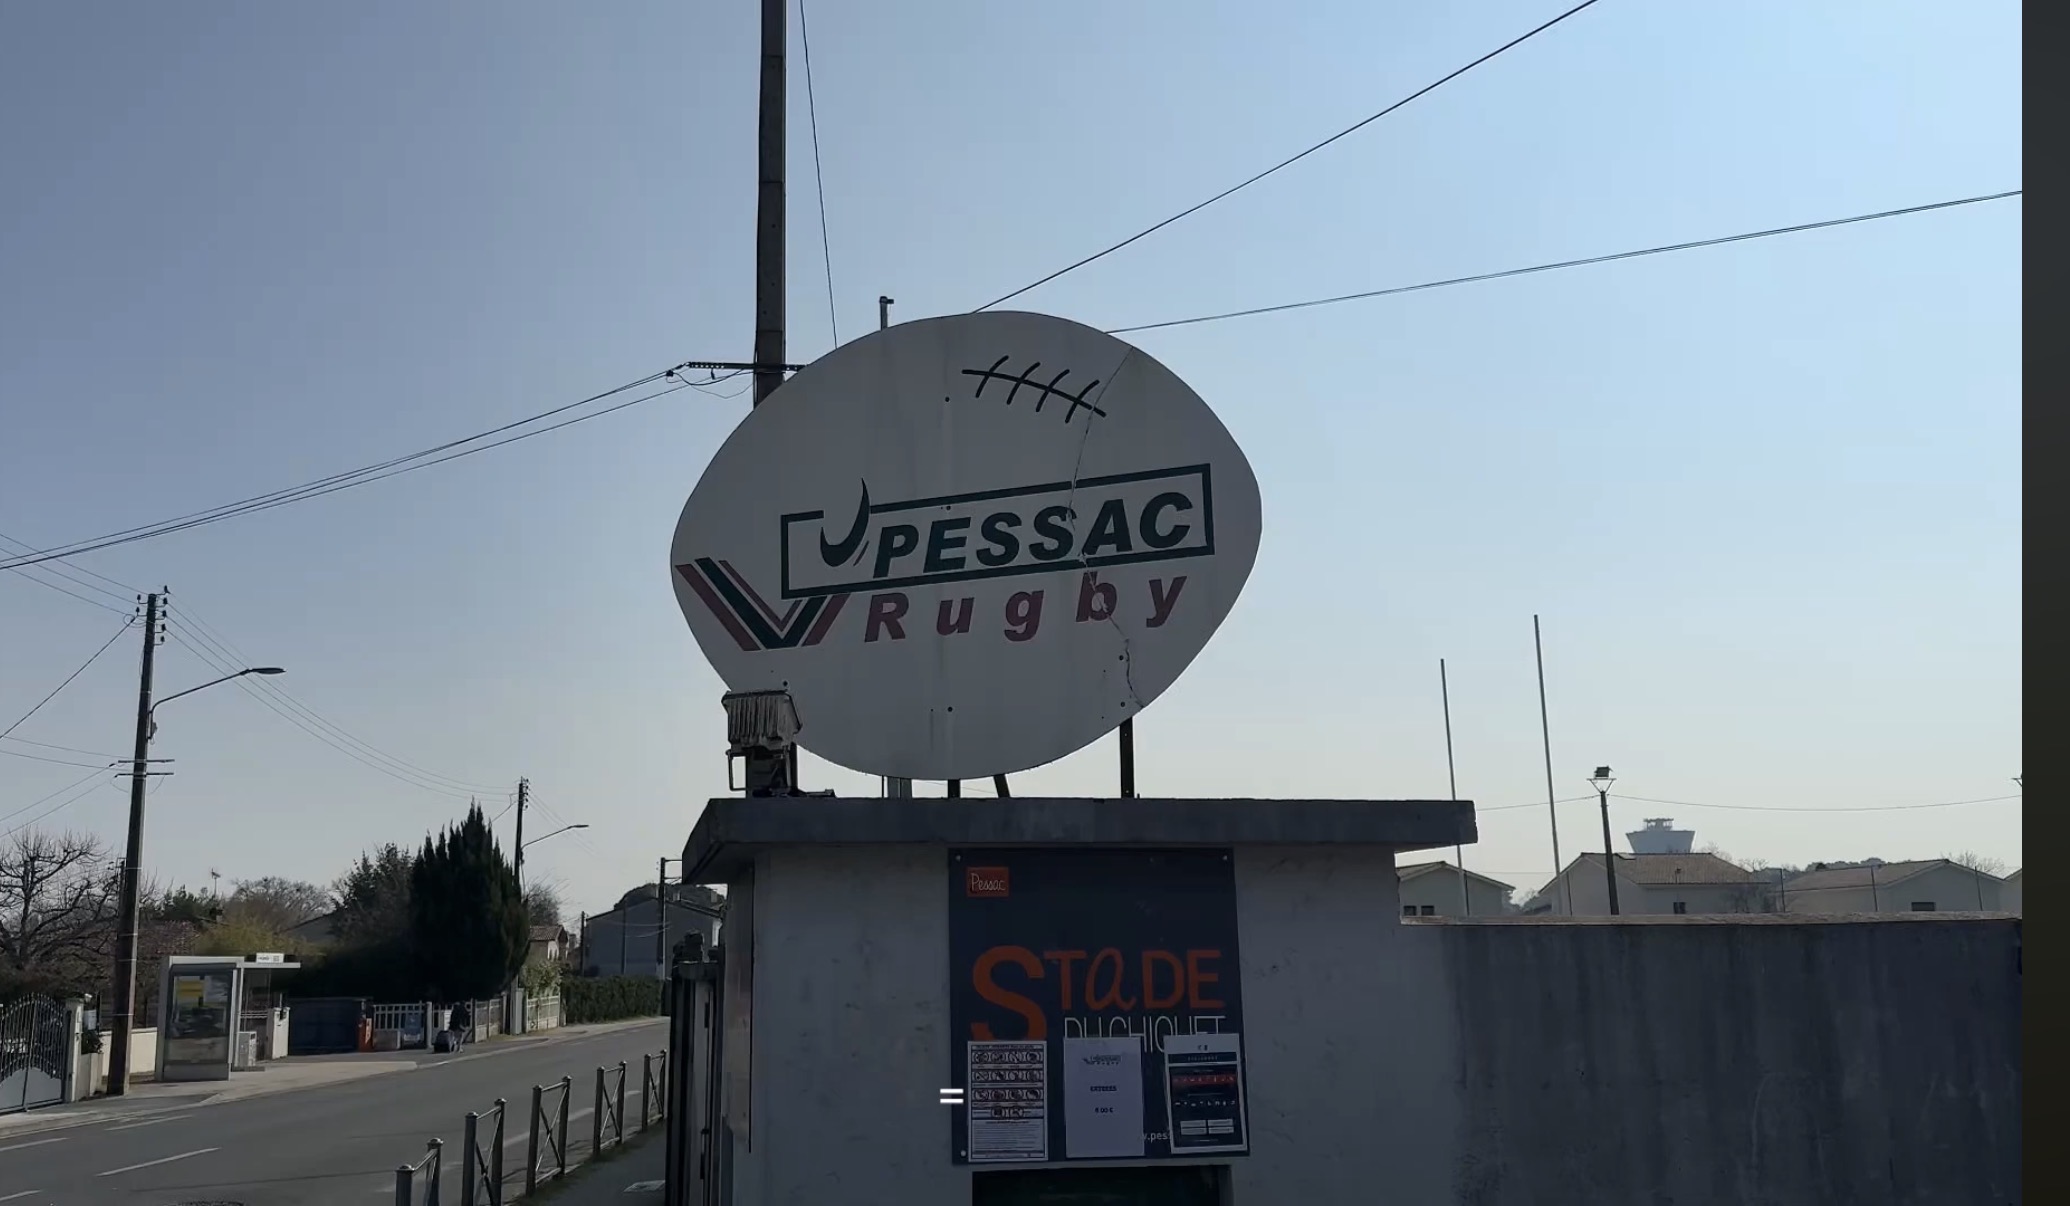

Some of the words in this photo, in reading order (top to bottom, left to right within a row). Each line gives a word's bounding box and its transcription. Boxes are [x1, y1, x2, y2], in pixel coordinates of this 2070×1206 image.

[873, 491, 1194, 580] PESSAC
[863, 572, 1188, 643] Rugby
[970, 872, 1006, 892] Pessac
